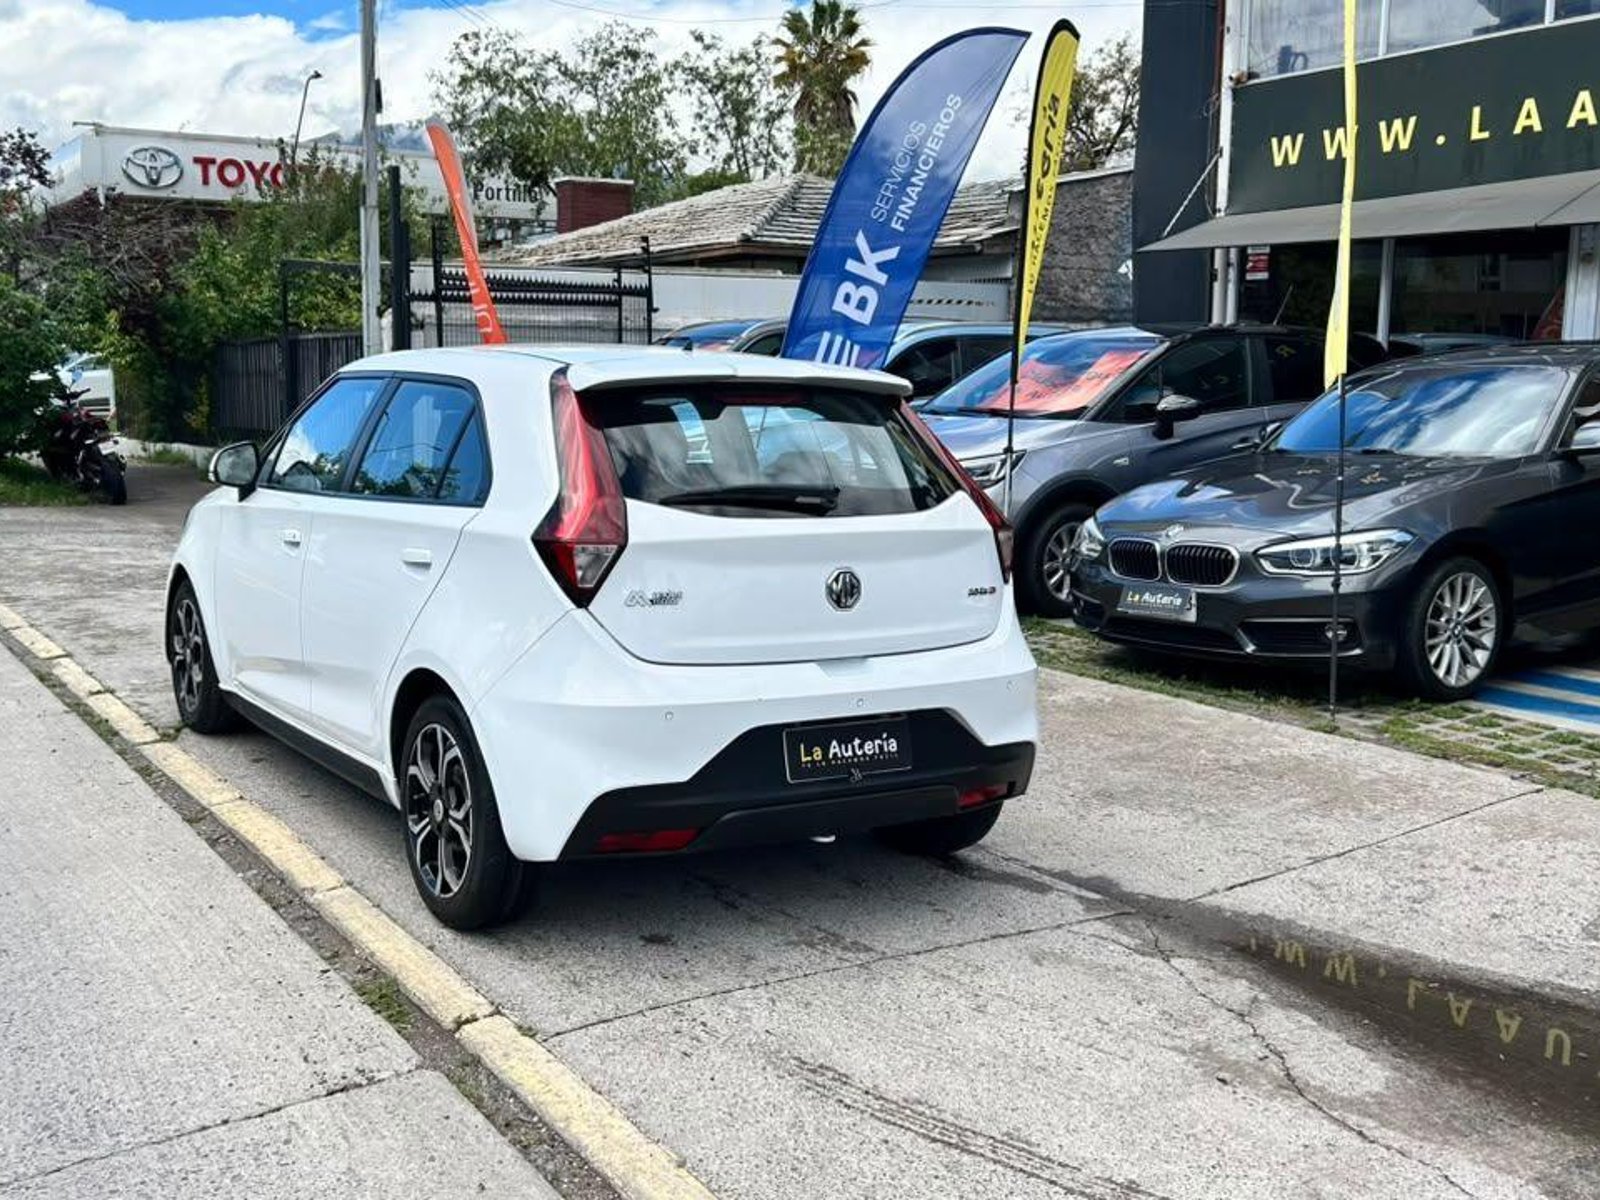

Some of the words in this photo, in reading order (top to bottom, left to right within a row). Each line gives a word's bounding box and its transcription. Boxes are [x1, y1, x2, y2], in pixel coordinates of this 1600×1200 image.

[871, 120, 927, 223] SERVICIOS
[890, 93, 961, 232] FINANCIEROS
[832, 229, 900, 326] BK
[800, 743, 822, 762] La
[829, 732, 898, 759] Autería
